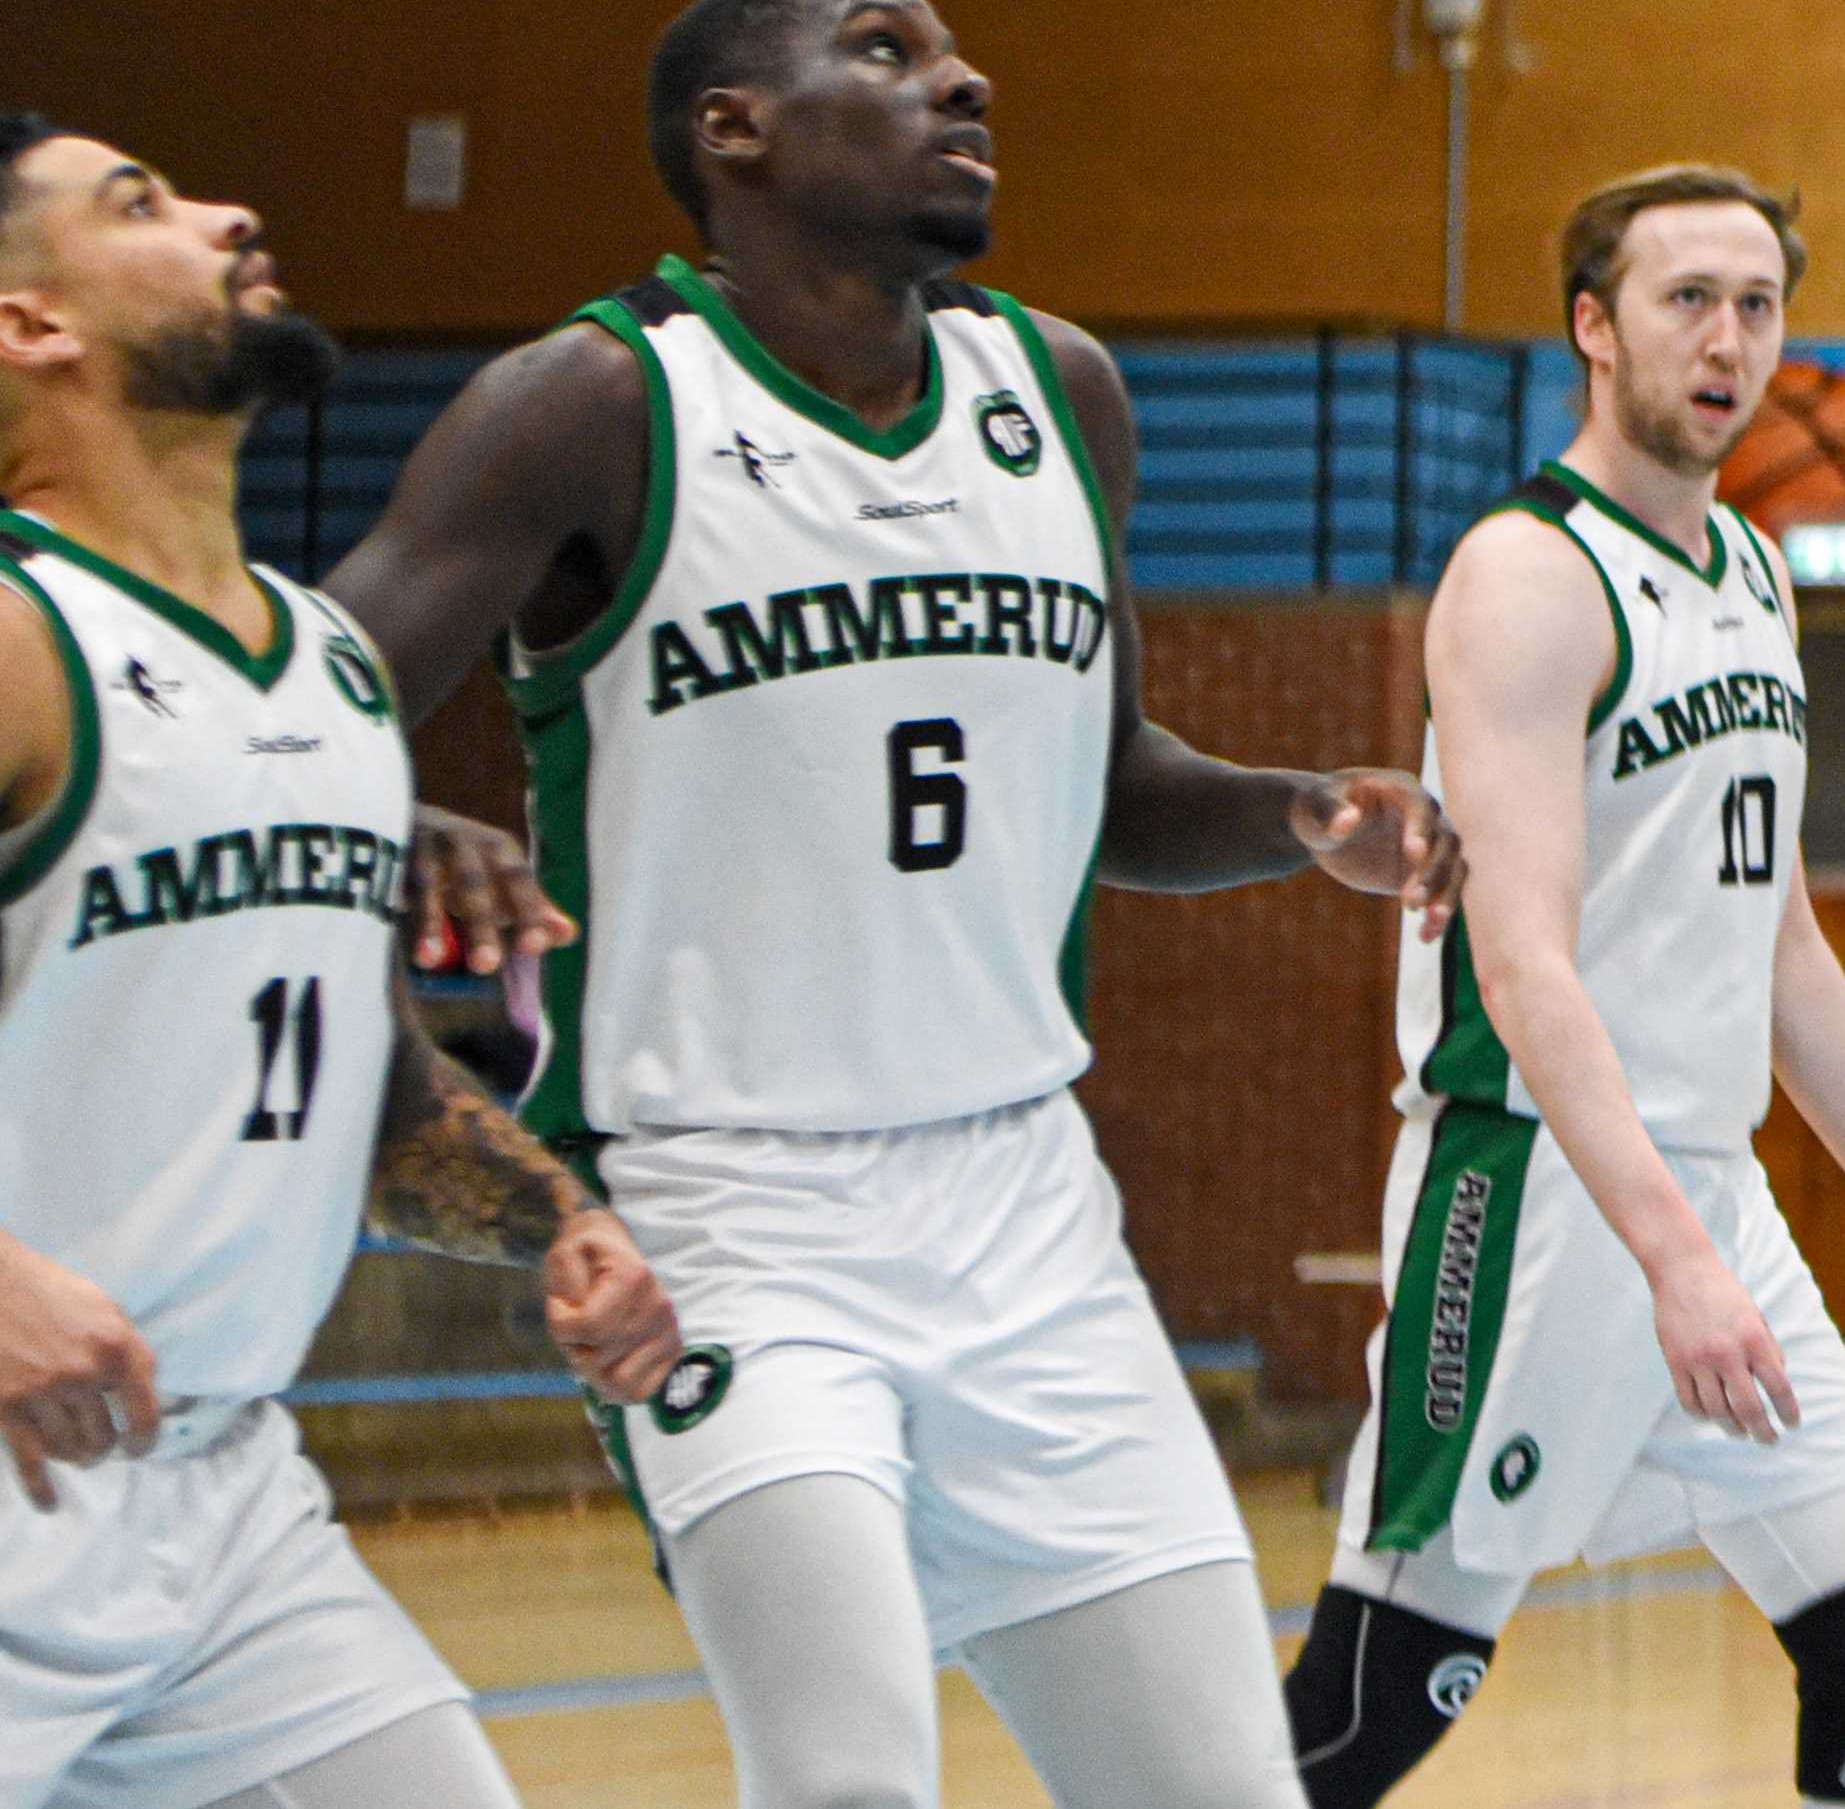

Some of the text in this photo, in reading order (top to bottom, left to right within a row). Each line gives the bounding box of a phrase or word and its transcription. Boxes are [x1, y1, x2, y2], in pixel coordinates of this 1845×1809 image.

[645, 571, 1109, 716] AMMERUD
[886, 717, 970, 874] 6
[1718, 775, 1777, 886] 10
[240, 976, 323, 1143] 11
[1424, 1167, 1493, 1434] AMMERUD
